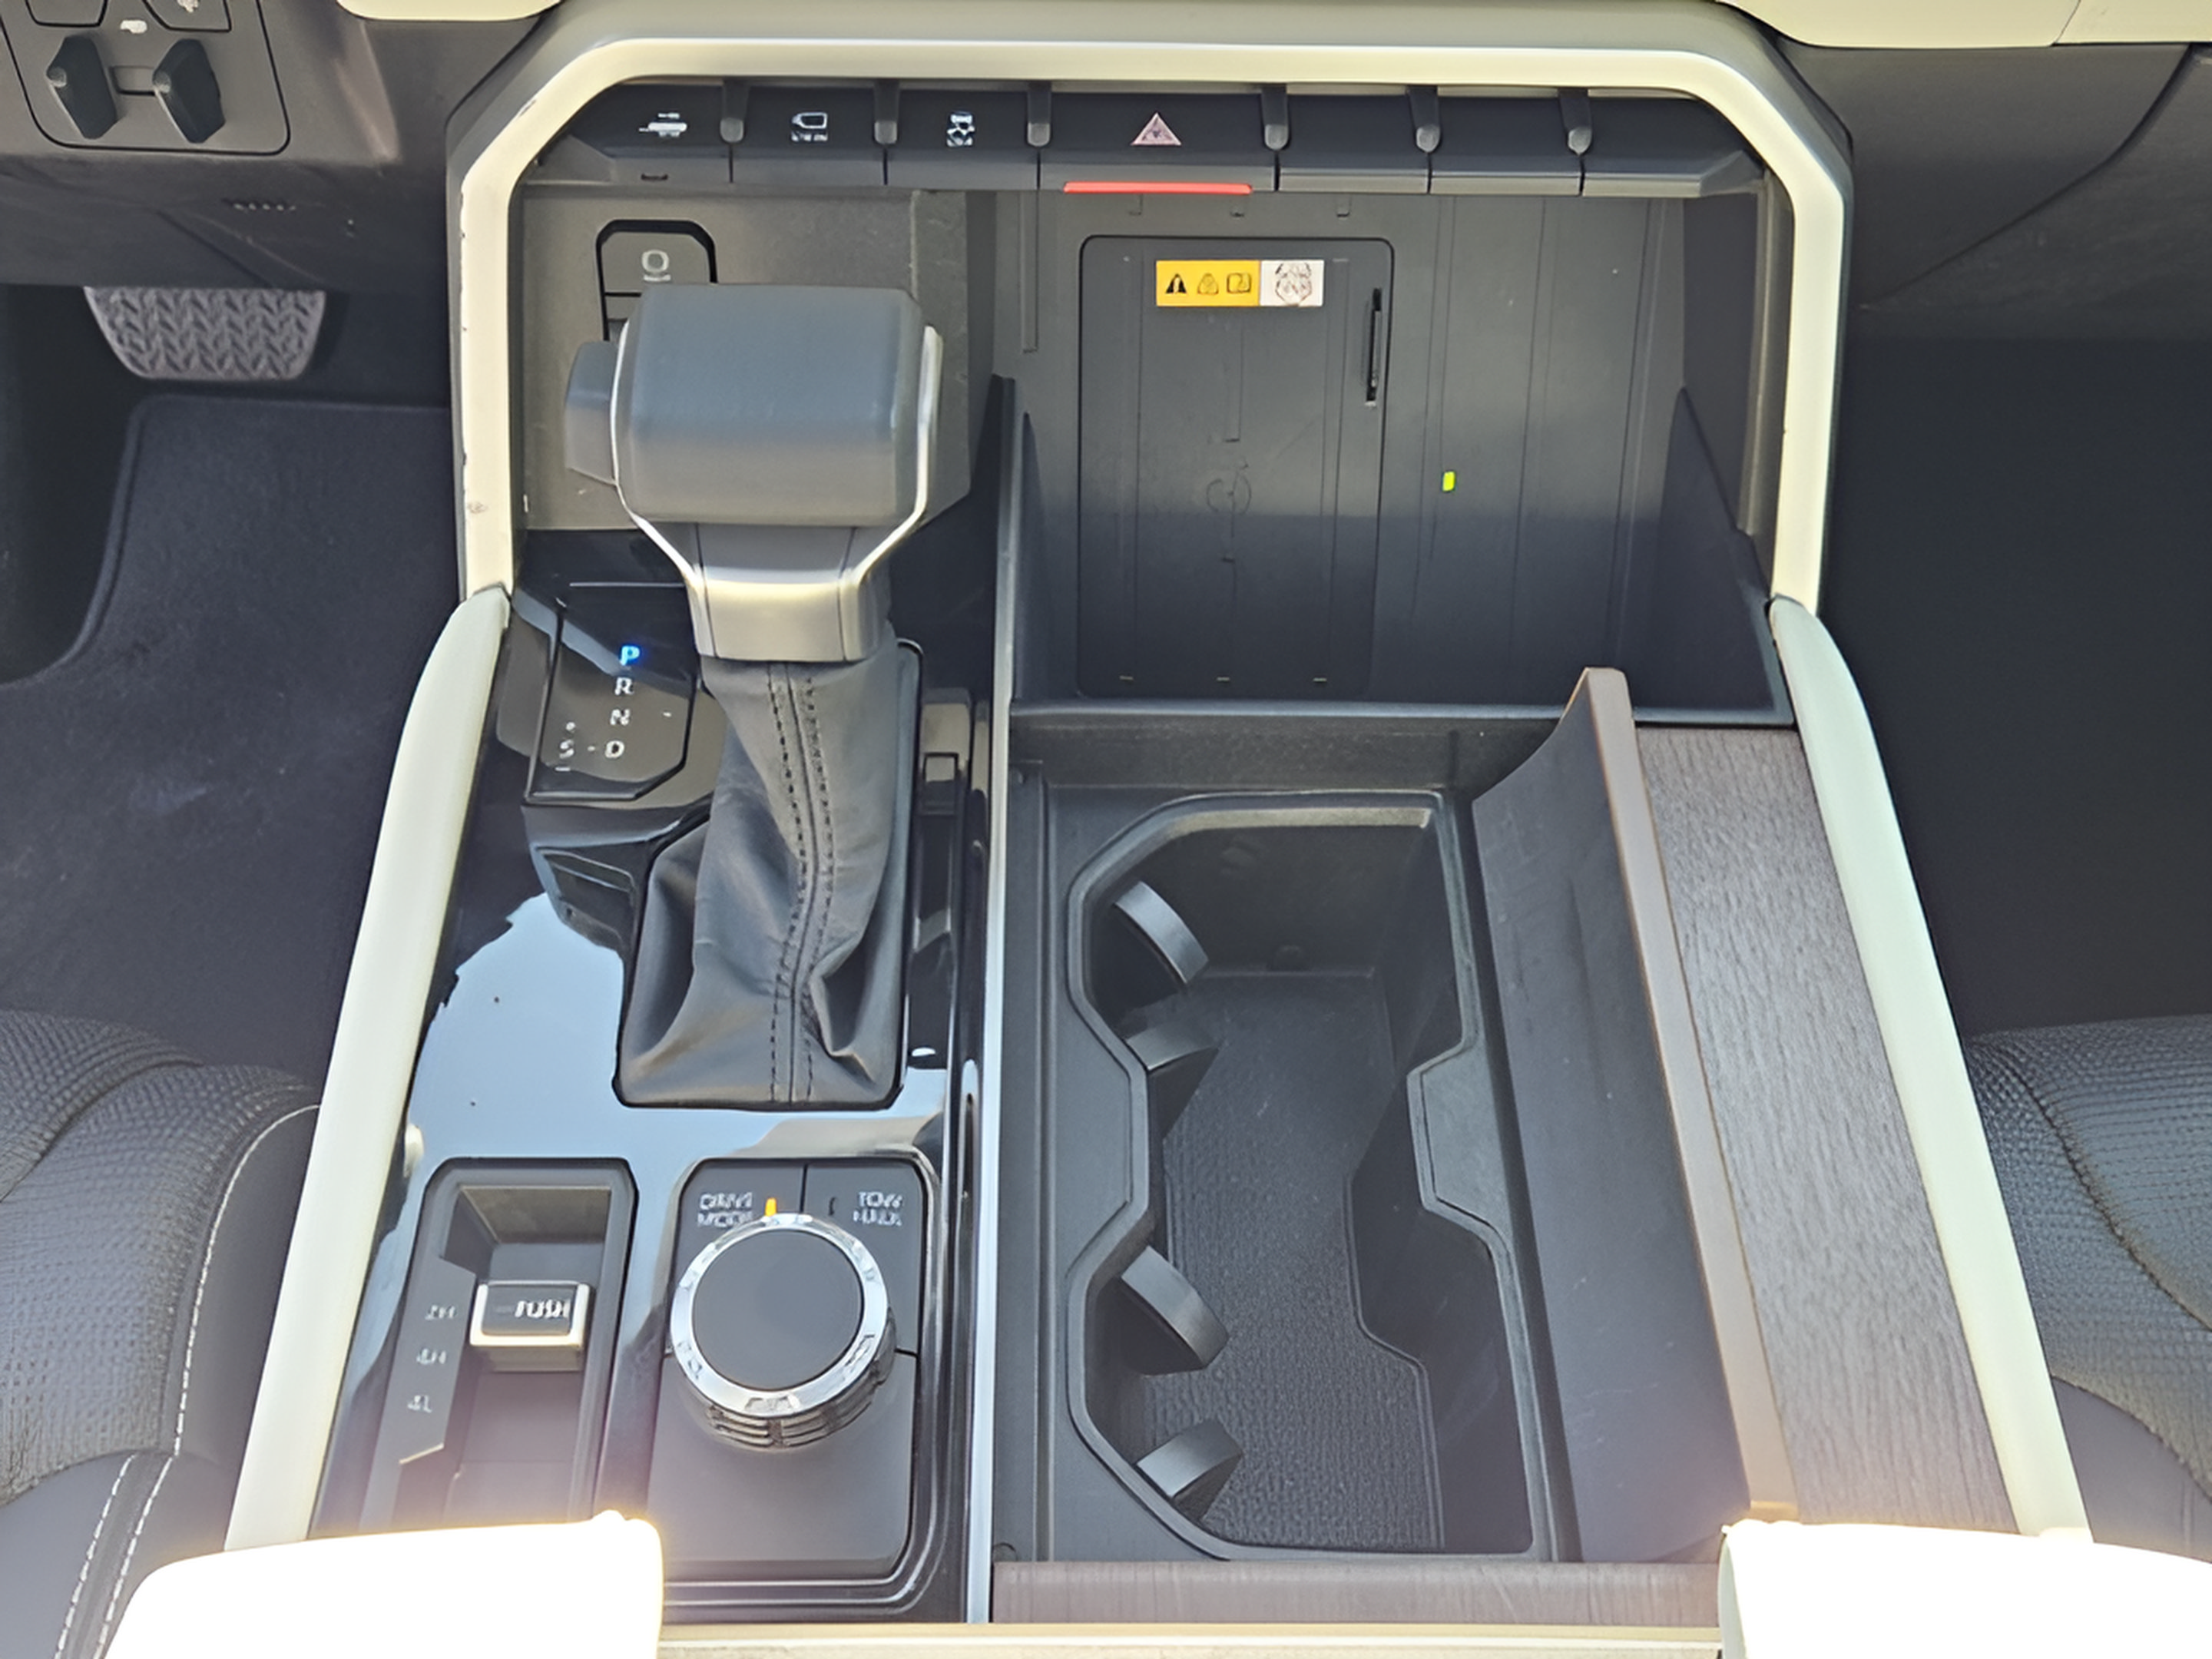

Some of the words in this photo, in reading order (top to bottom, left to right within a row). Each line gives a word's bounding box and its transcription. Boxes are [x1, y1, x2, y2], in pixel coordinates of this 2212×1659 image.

[620, 645, 640, 666] P
[614, 677, 634, 695] R
[610, 709, 630, 725] N
